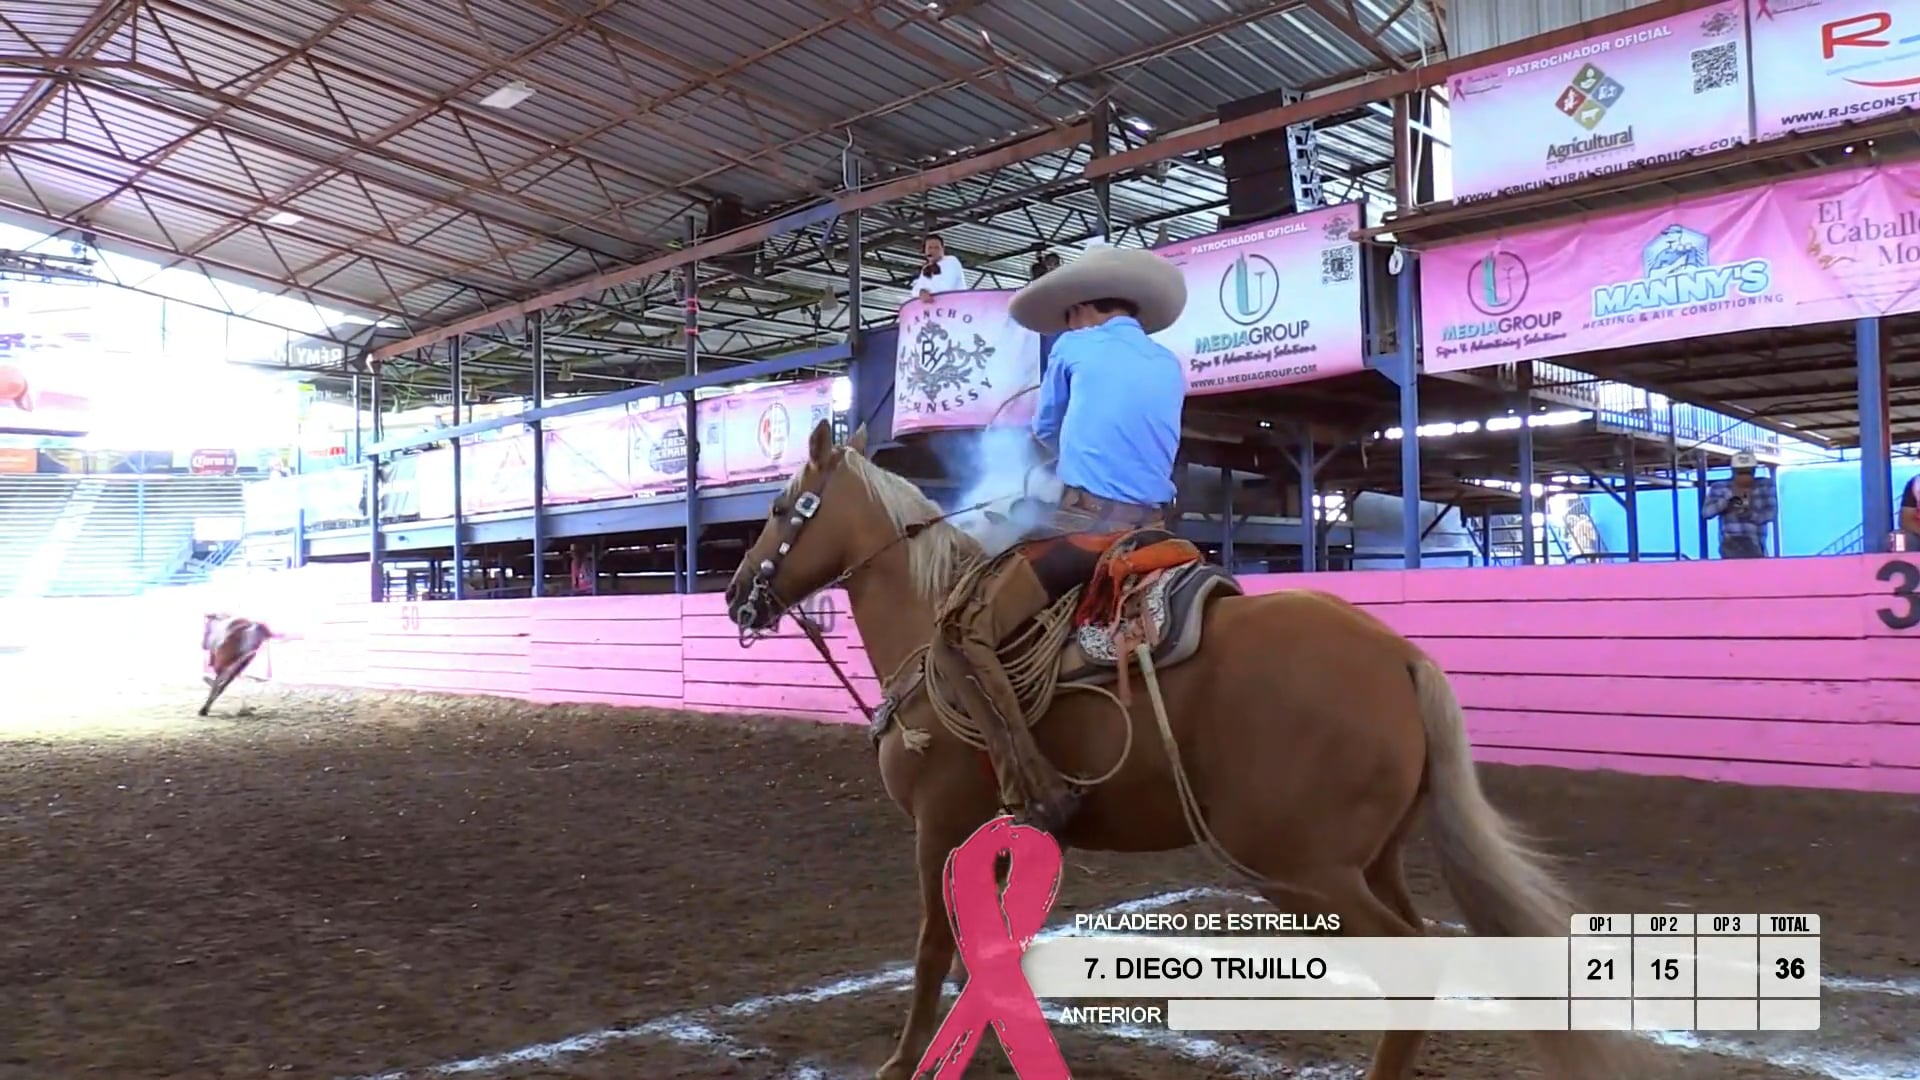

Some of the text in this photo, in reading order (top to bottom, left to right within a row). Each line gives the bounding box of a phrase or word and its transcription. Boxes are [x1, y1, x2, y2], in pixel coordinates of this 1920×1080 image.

[1507, 25, 1672, 77] PATROCINADOR OFICIAL
[1780, 91, 1920, 126] WWW.RJSCONST
[1546, 125, 1635, 164] Agricultural
[1818, 199, 1843, 224] El
[1827, 210, 1920, 245] Caball
[1191, 232, 1265, 255] PATROCINADOR
[1267, 222, 1308, 239] OFICIAL
[1594, 259, 1770, 317] MANNY'S
[905, 308, 973, 334] ANCHO
[1442, 311, 1562, 341] MEDIAGROUP
[1582, 294, 1784, 329] HEATING & AIR CONDITIONING
[1194, 320, 1310, 354] MEDIAGROUP
[1470, 338, 1521, 353] Advertising
[1523, 331, 1567, 345] Solutions
[1222, 349, 1272, 366] Advertising
[1274, 343, 1318, 356] Solutions
[1190, 364, 1318, 389] WWW.U-MEDIAGROUP.COM
[1875, 560, 1920, 630] 3
[401, 605, 420, 631] 50
